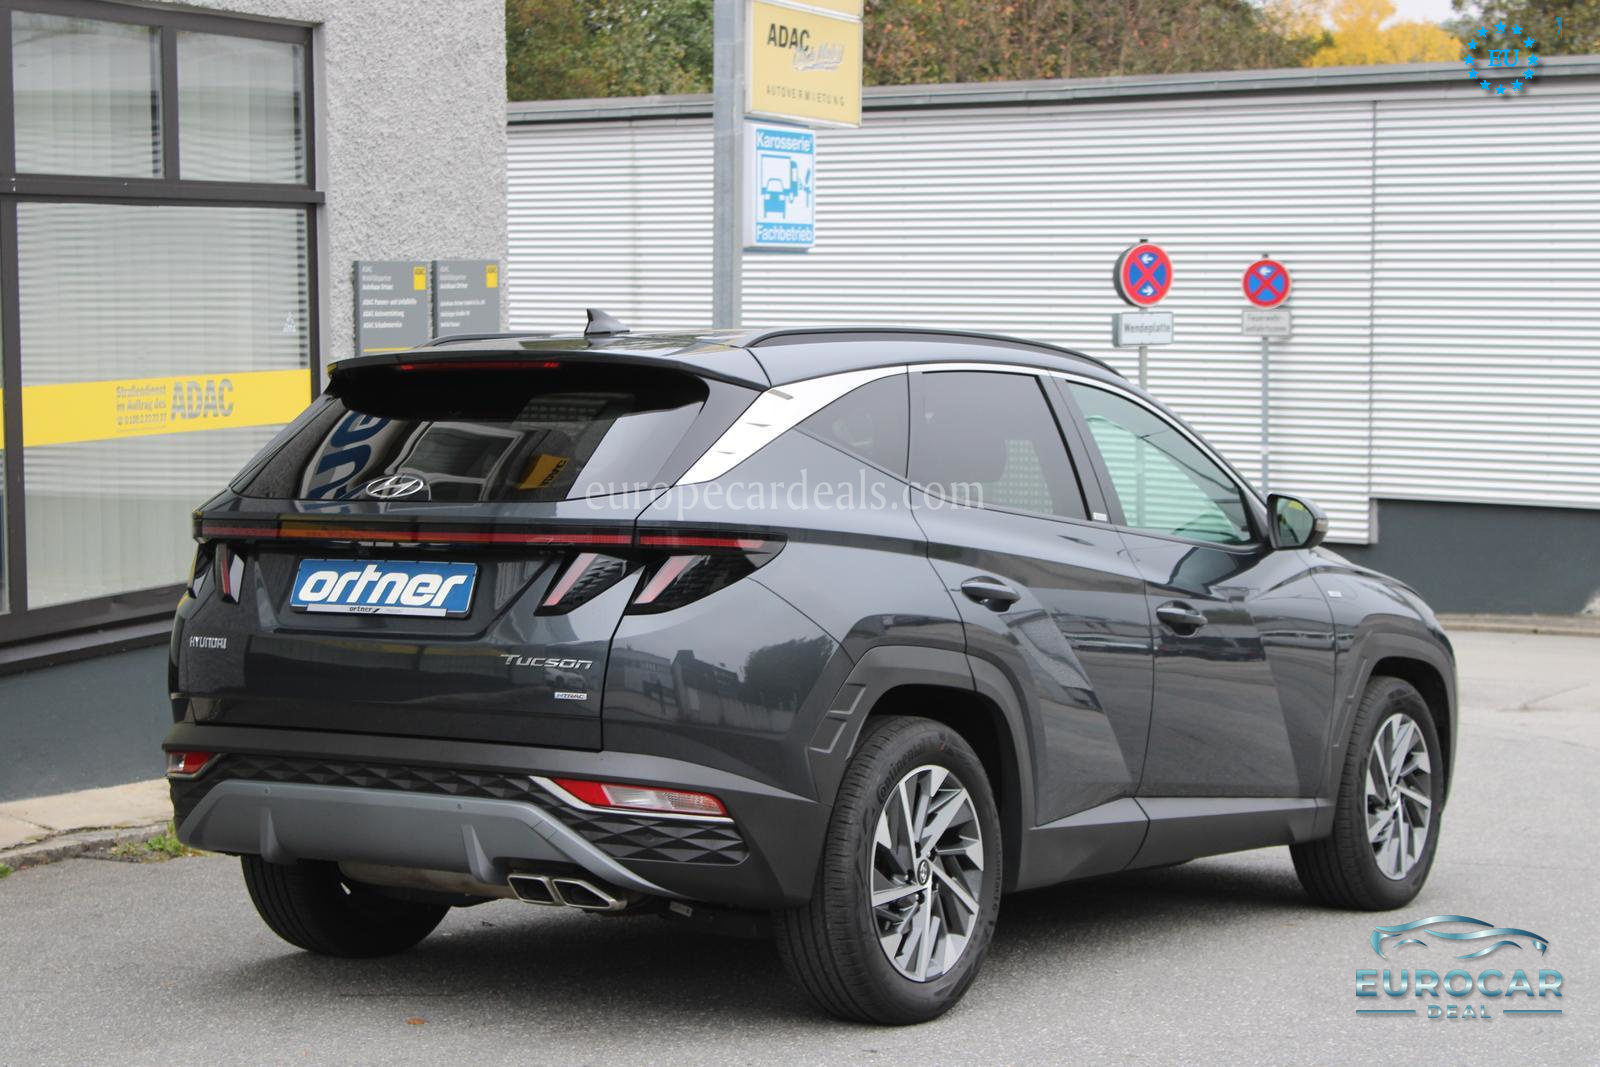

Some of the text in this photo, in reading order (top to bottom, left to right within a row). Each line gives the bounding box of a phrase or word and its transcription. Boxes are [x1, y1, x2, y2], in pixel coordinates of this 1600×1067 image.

[767, 23, 810, 52] ADAC
[766, 85, 845, 107] AUTOVERMIETUNG
[757, 132, 812, 151] Karosserie
[757, 224, 813, 242] Fachbetrieb
[1124, 323, 1171, 336] Wendeplatte
[170, 379, 234, 421] ADAC
[298, 564, 468, 607] ortner
[190, 636, 227, 649] HYUNDAI
